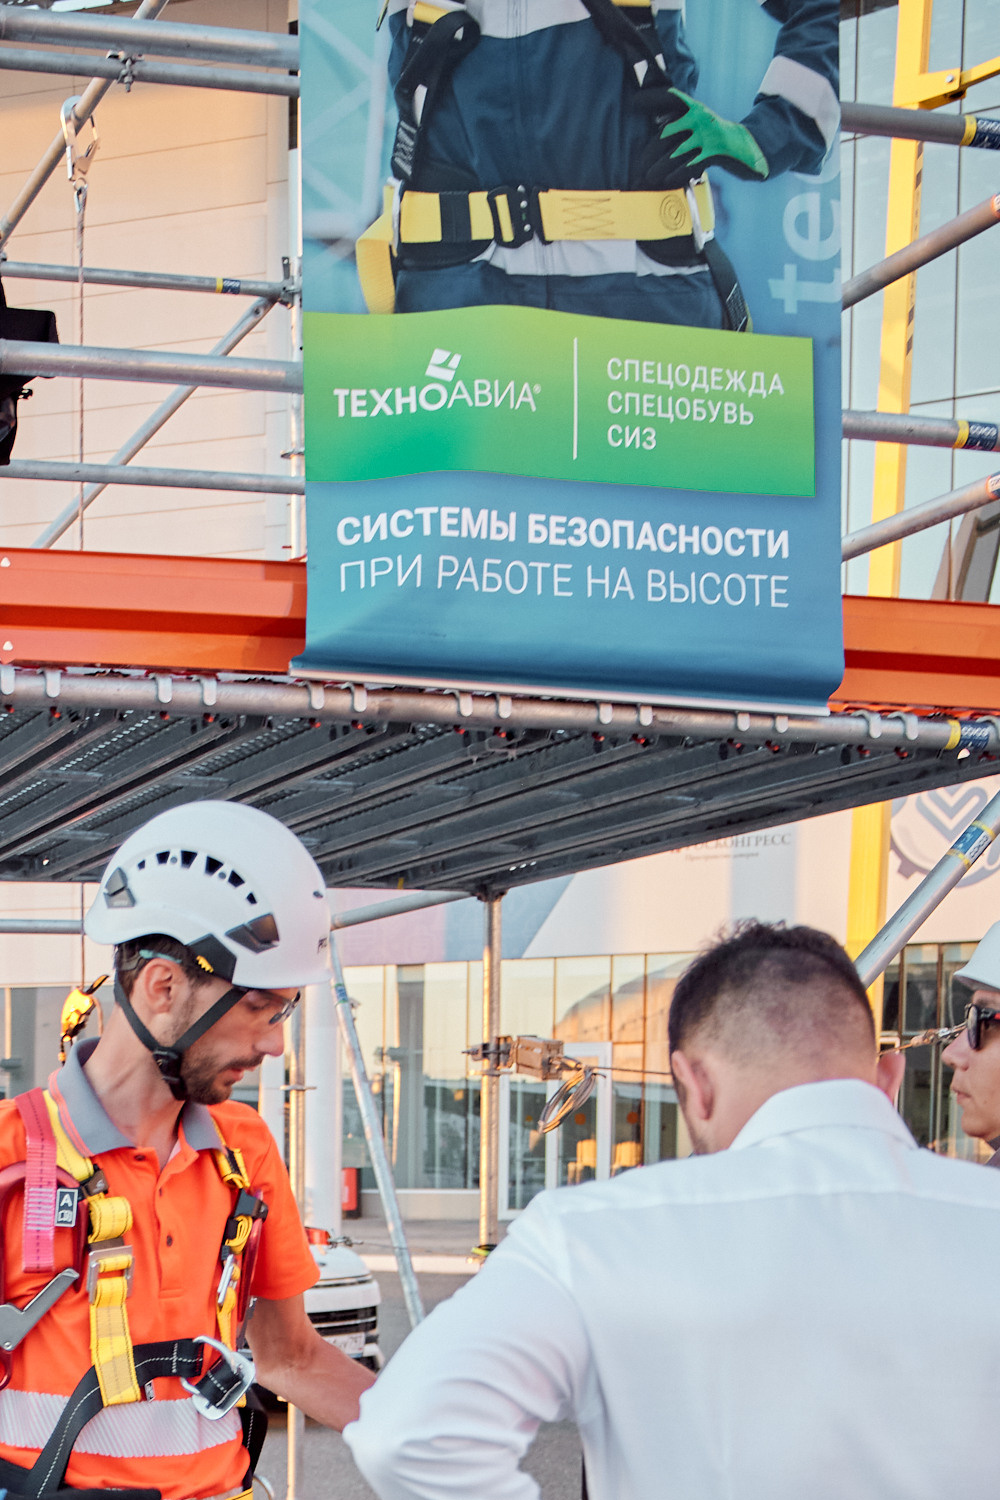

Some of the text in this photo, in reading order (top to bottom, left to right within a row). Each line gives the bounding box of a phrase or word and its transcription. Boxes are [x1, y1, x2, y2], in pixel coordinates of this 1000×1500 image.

[606, 356, 785, 400] СПЕЦОДЕЖДА
[607, 390, 755, 426] СПЕЦОБУВЬ
[607, 423, 657, 450] СИЗ
[336, 506, 789, 559] СИСТЕМЫ БЕЗОПАСНОСТИ
[340, 553, 789, 608] ПРИ РАБОТЕ НА ВЫСОТЕ
